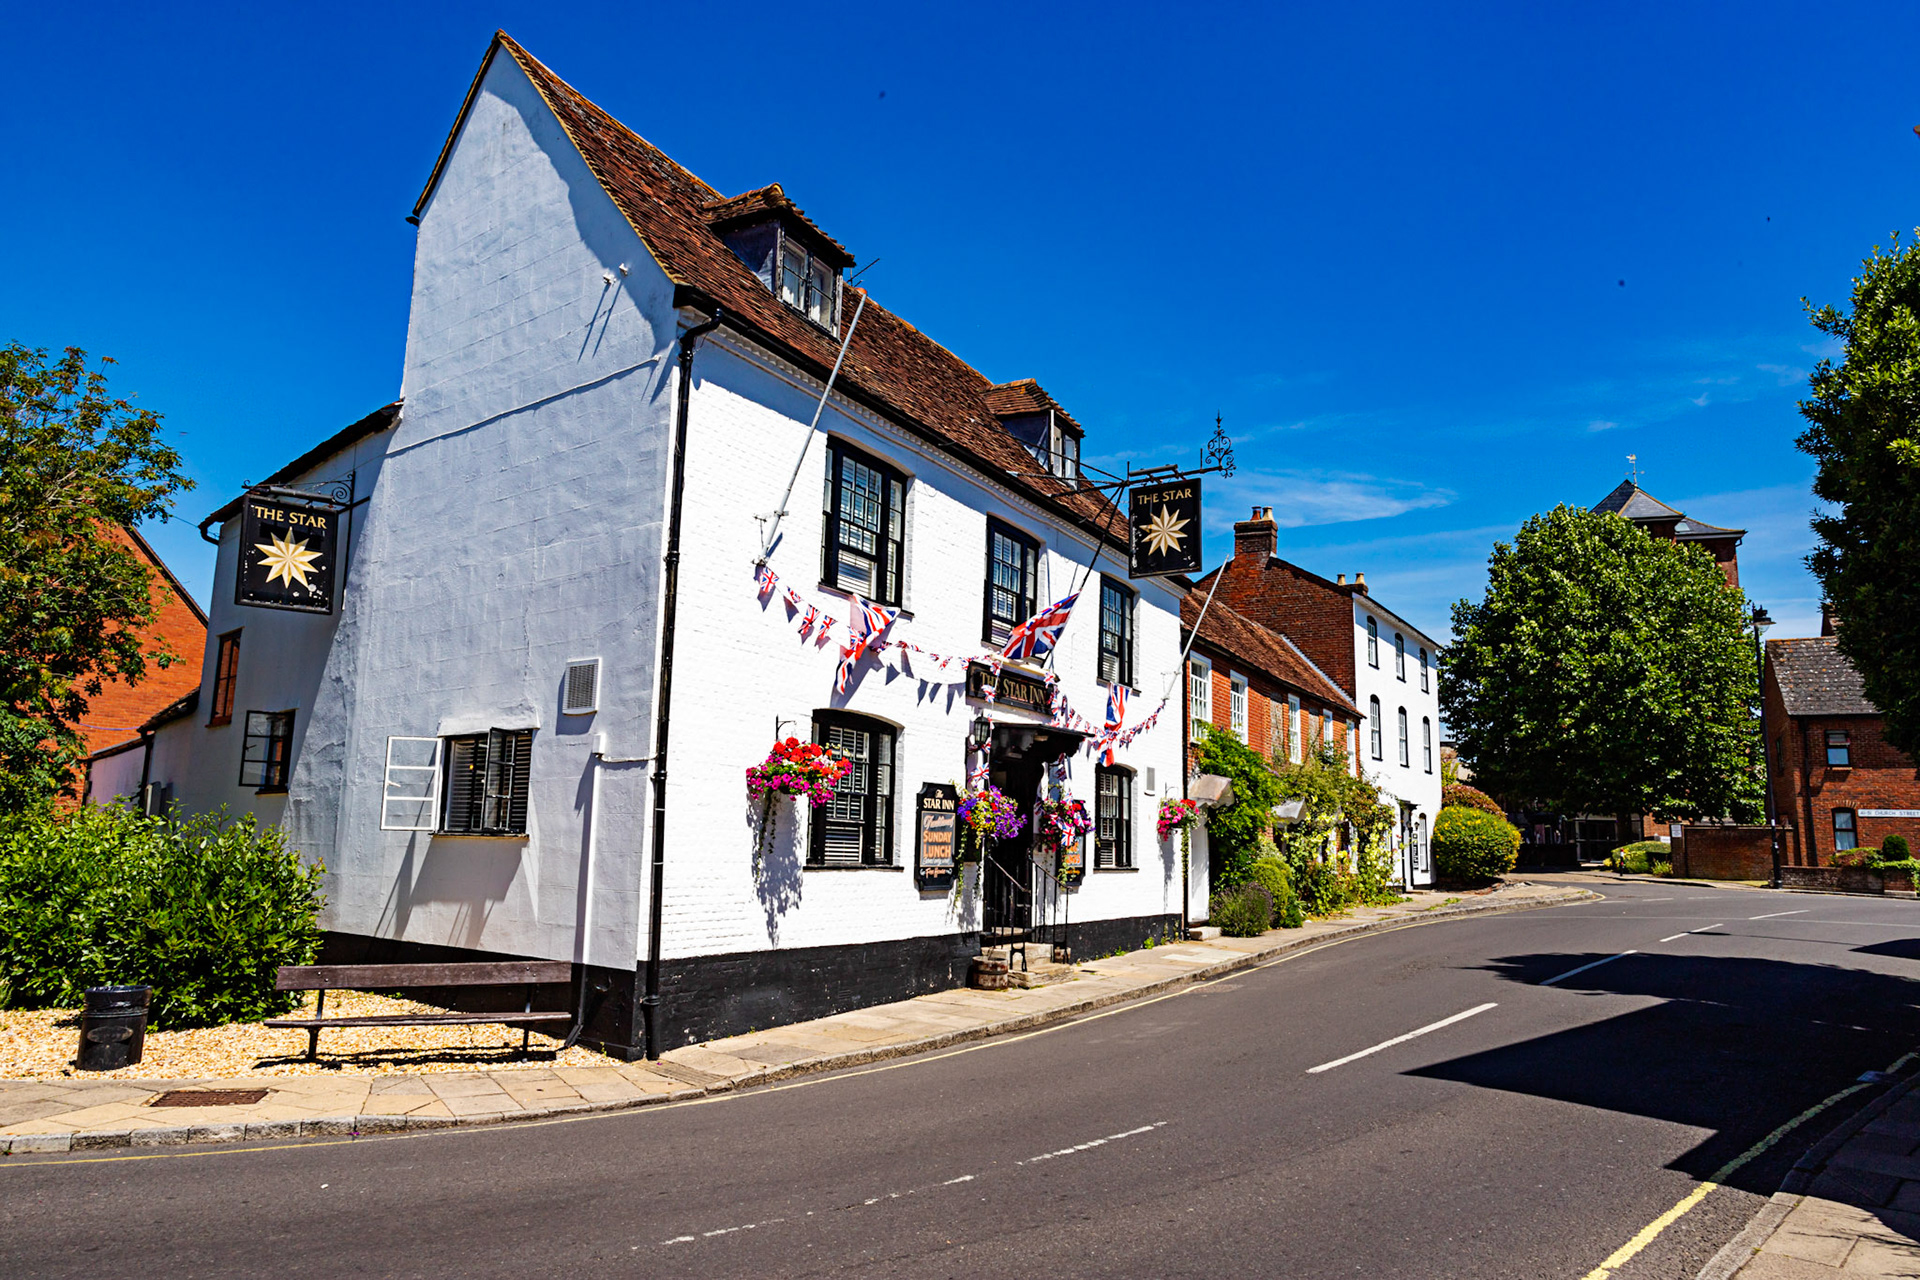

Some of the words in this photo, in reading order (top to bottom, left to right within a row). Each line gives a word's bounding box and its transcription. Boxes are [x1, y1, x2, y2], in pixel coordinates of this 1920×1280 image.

[1137, 493, 1160, 505] THE
[1162, 488, 1193, 502] STAR
[255, 505, 285, 522] THE
[288, 512, 327, 529] STAR
[1003, 678, 1028, 703] STAR
[1029, 685, 1047, 706] INN
[923, 797, 941, 810] STAR
[941, 799, 955, 810] INN
[923, 830, 953, 843] SUNDAY
[923, 844, 952, 859] LUNCH
